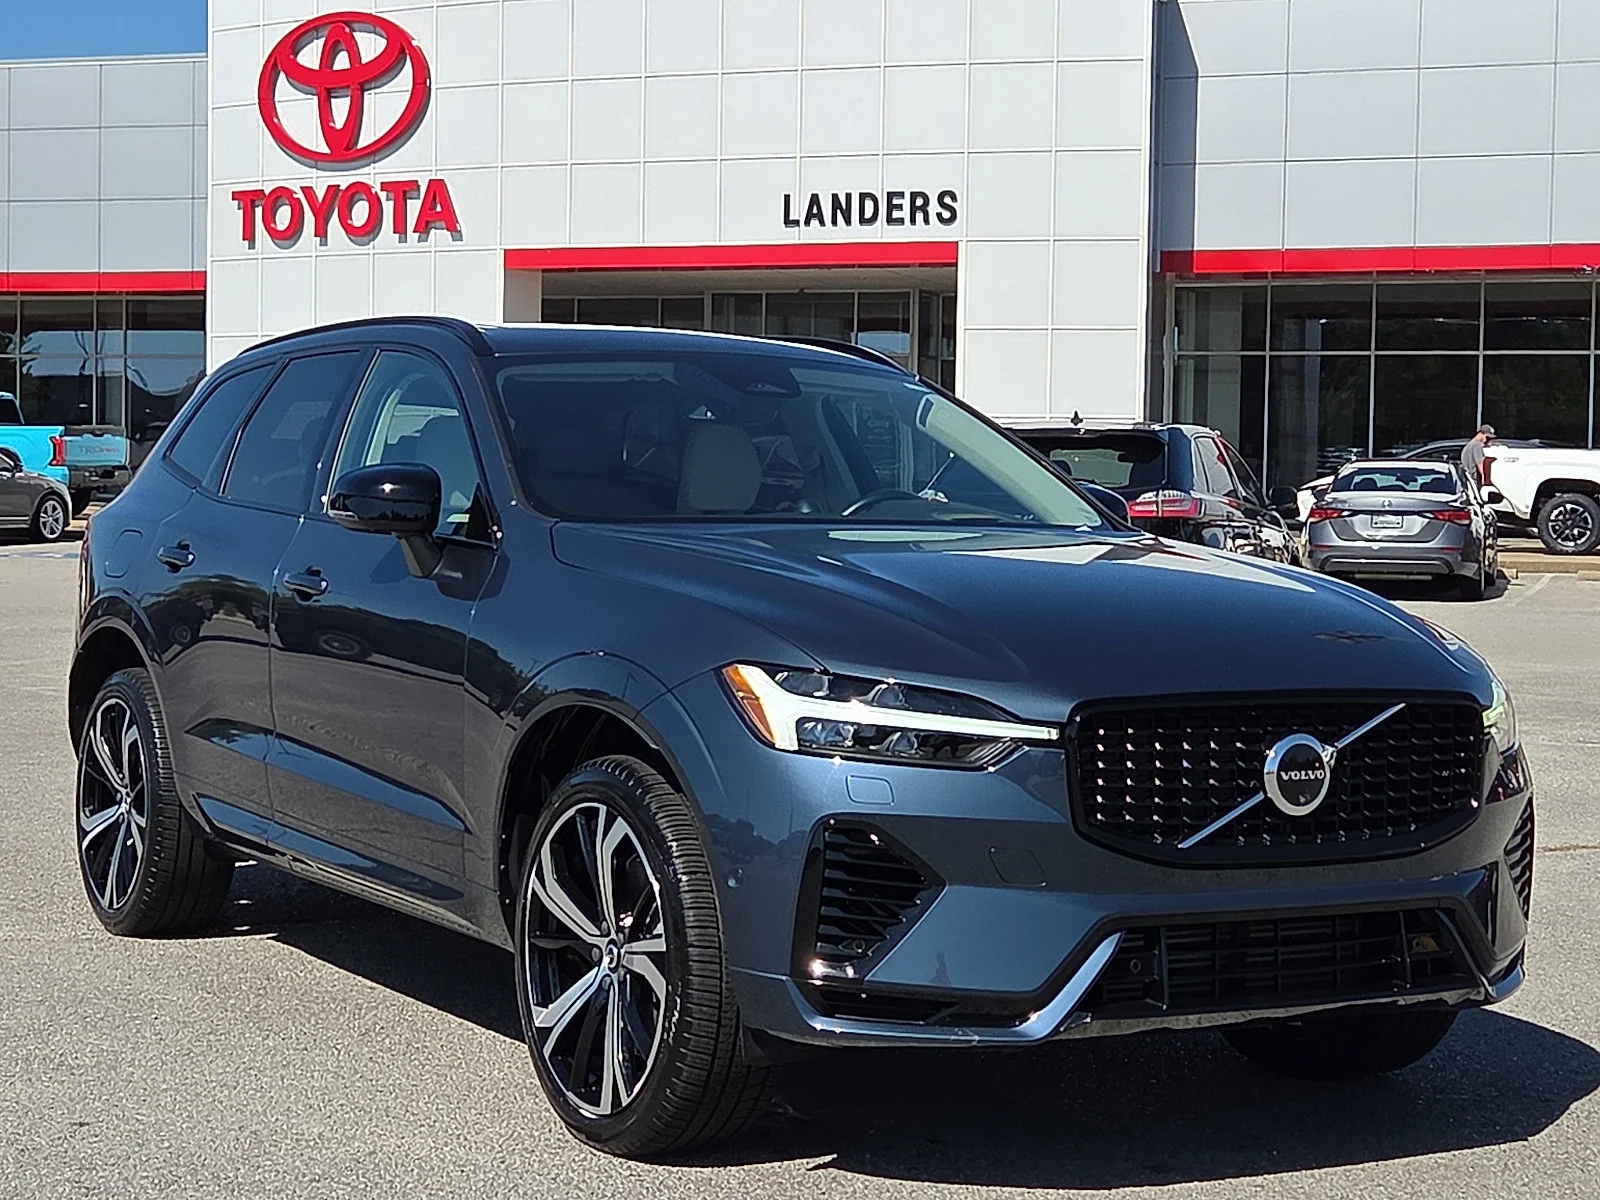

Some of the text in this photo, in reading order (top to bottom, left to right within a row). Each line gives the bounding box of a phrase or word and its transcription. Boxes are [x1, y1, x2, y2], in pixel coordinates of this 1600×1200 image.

[232, 179, 461, 247] TOYOTA
[783, 190, 958, 228] LANDERS
[1280, 769, 1325, 780] VOLVO
